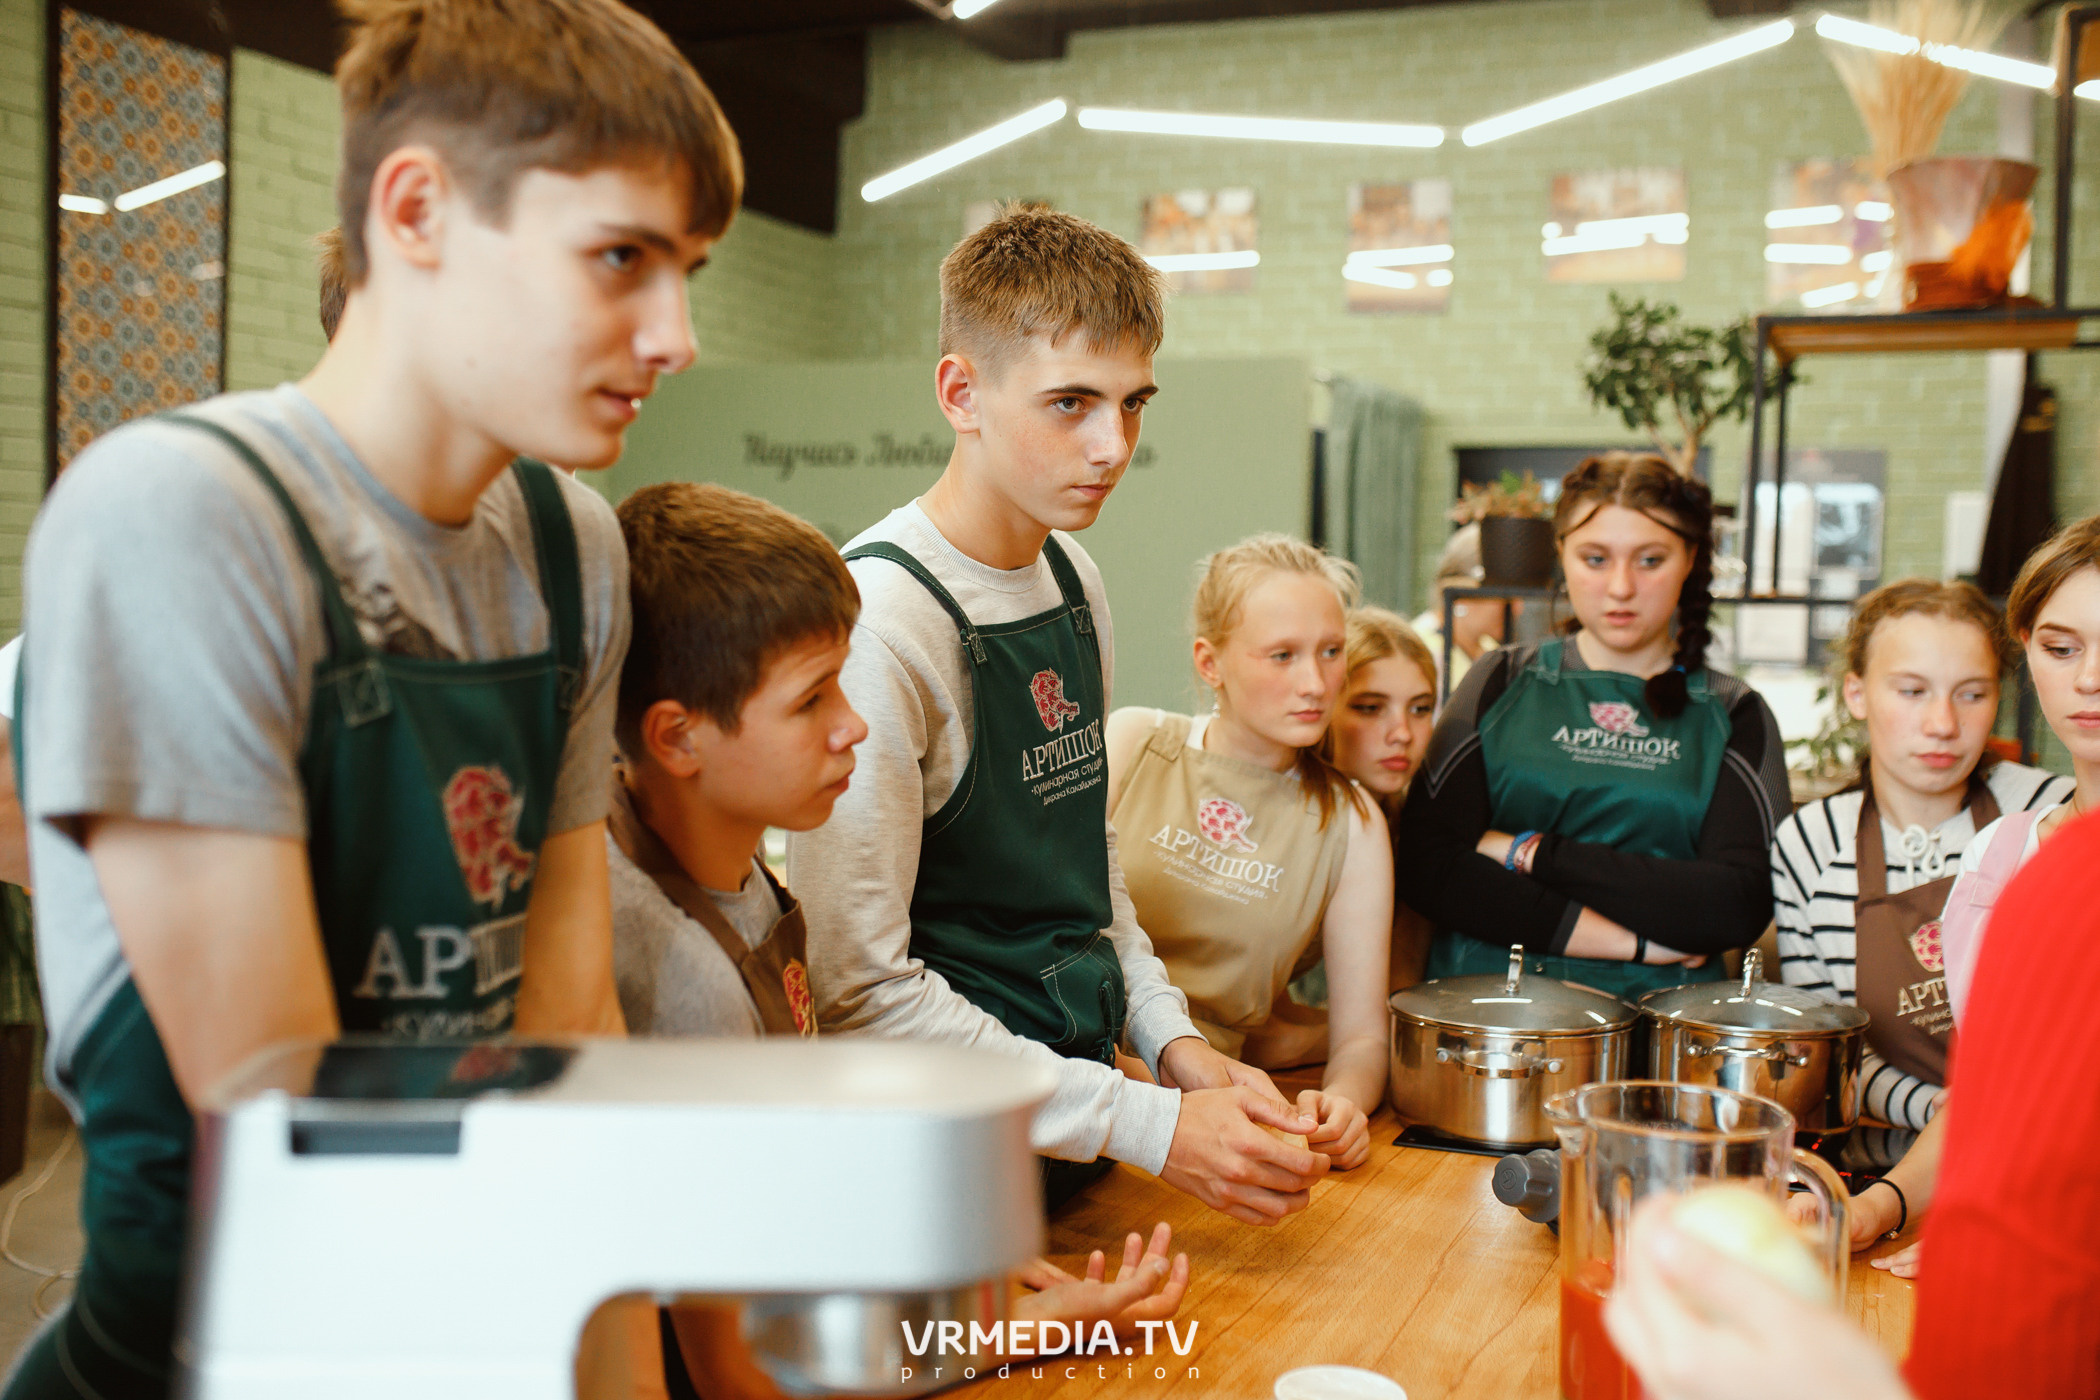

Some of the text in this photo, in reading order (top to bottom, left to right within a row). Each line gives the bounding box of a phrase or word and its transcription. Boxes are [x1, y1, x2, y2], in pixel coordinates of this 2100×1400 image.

[1022, 718, 1103, 782] АРТИШОК
[1551, 725, 1681, 760] АРТИШОК
[1149, 824, 1284, 893] АРТИШОК
[1896, 976, 1950, 1017] АРТ
